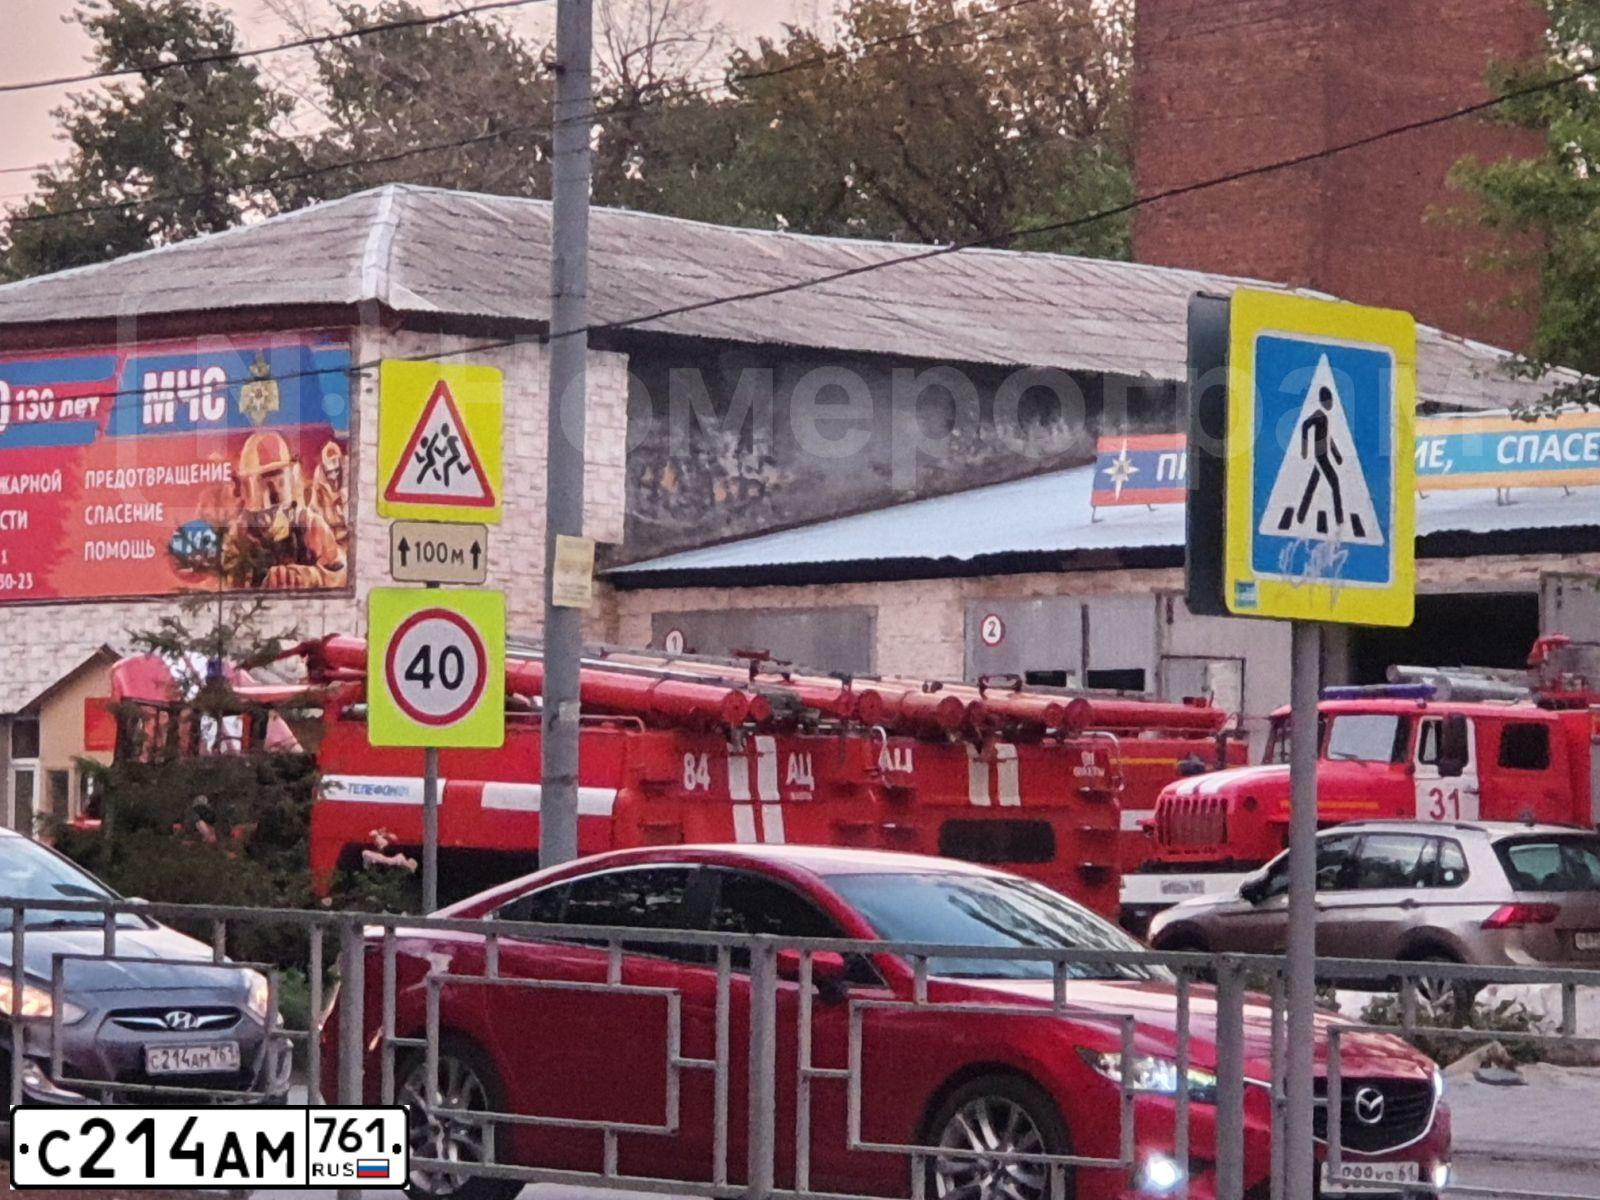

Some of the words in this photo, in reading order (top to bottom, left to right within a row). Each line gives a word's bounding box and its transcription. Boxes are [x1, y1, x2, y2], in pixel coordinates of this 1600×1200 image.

[15, 387, 55, 421] 130
[59, 396, 100, 418] лет
[142, 366, 227, 425] МЧС
[1497, 432, 1600, 465] СПАСЕ
[84, 462, 233, 490] ПРЕДОТВРАЩЕНИЕ
[0, 509, 29, 531] СТИ
[84, 502, 165, 526] СПАСЕНИЕ
[84, 540, 157, 562] ПОМОЩЬ
[987, 620, 997, 638] 2
[405, 644, 465, 691] 40
[683, 752, 711, 791] 84
[785, 751, 815, 791] АЦ
[1429, 787, 1460, 821] 31
